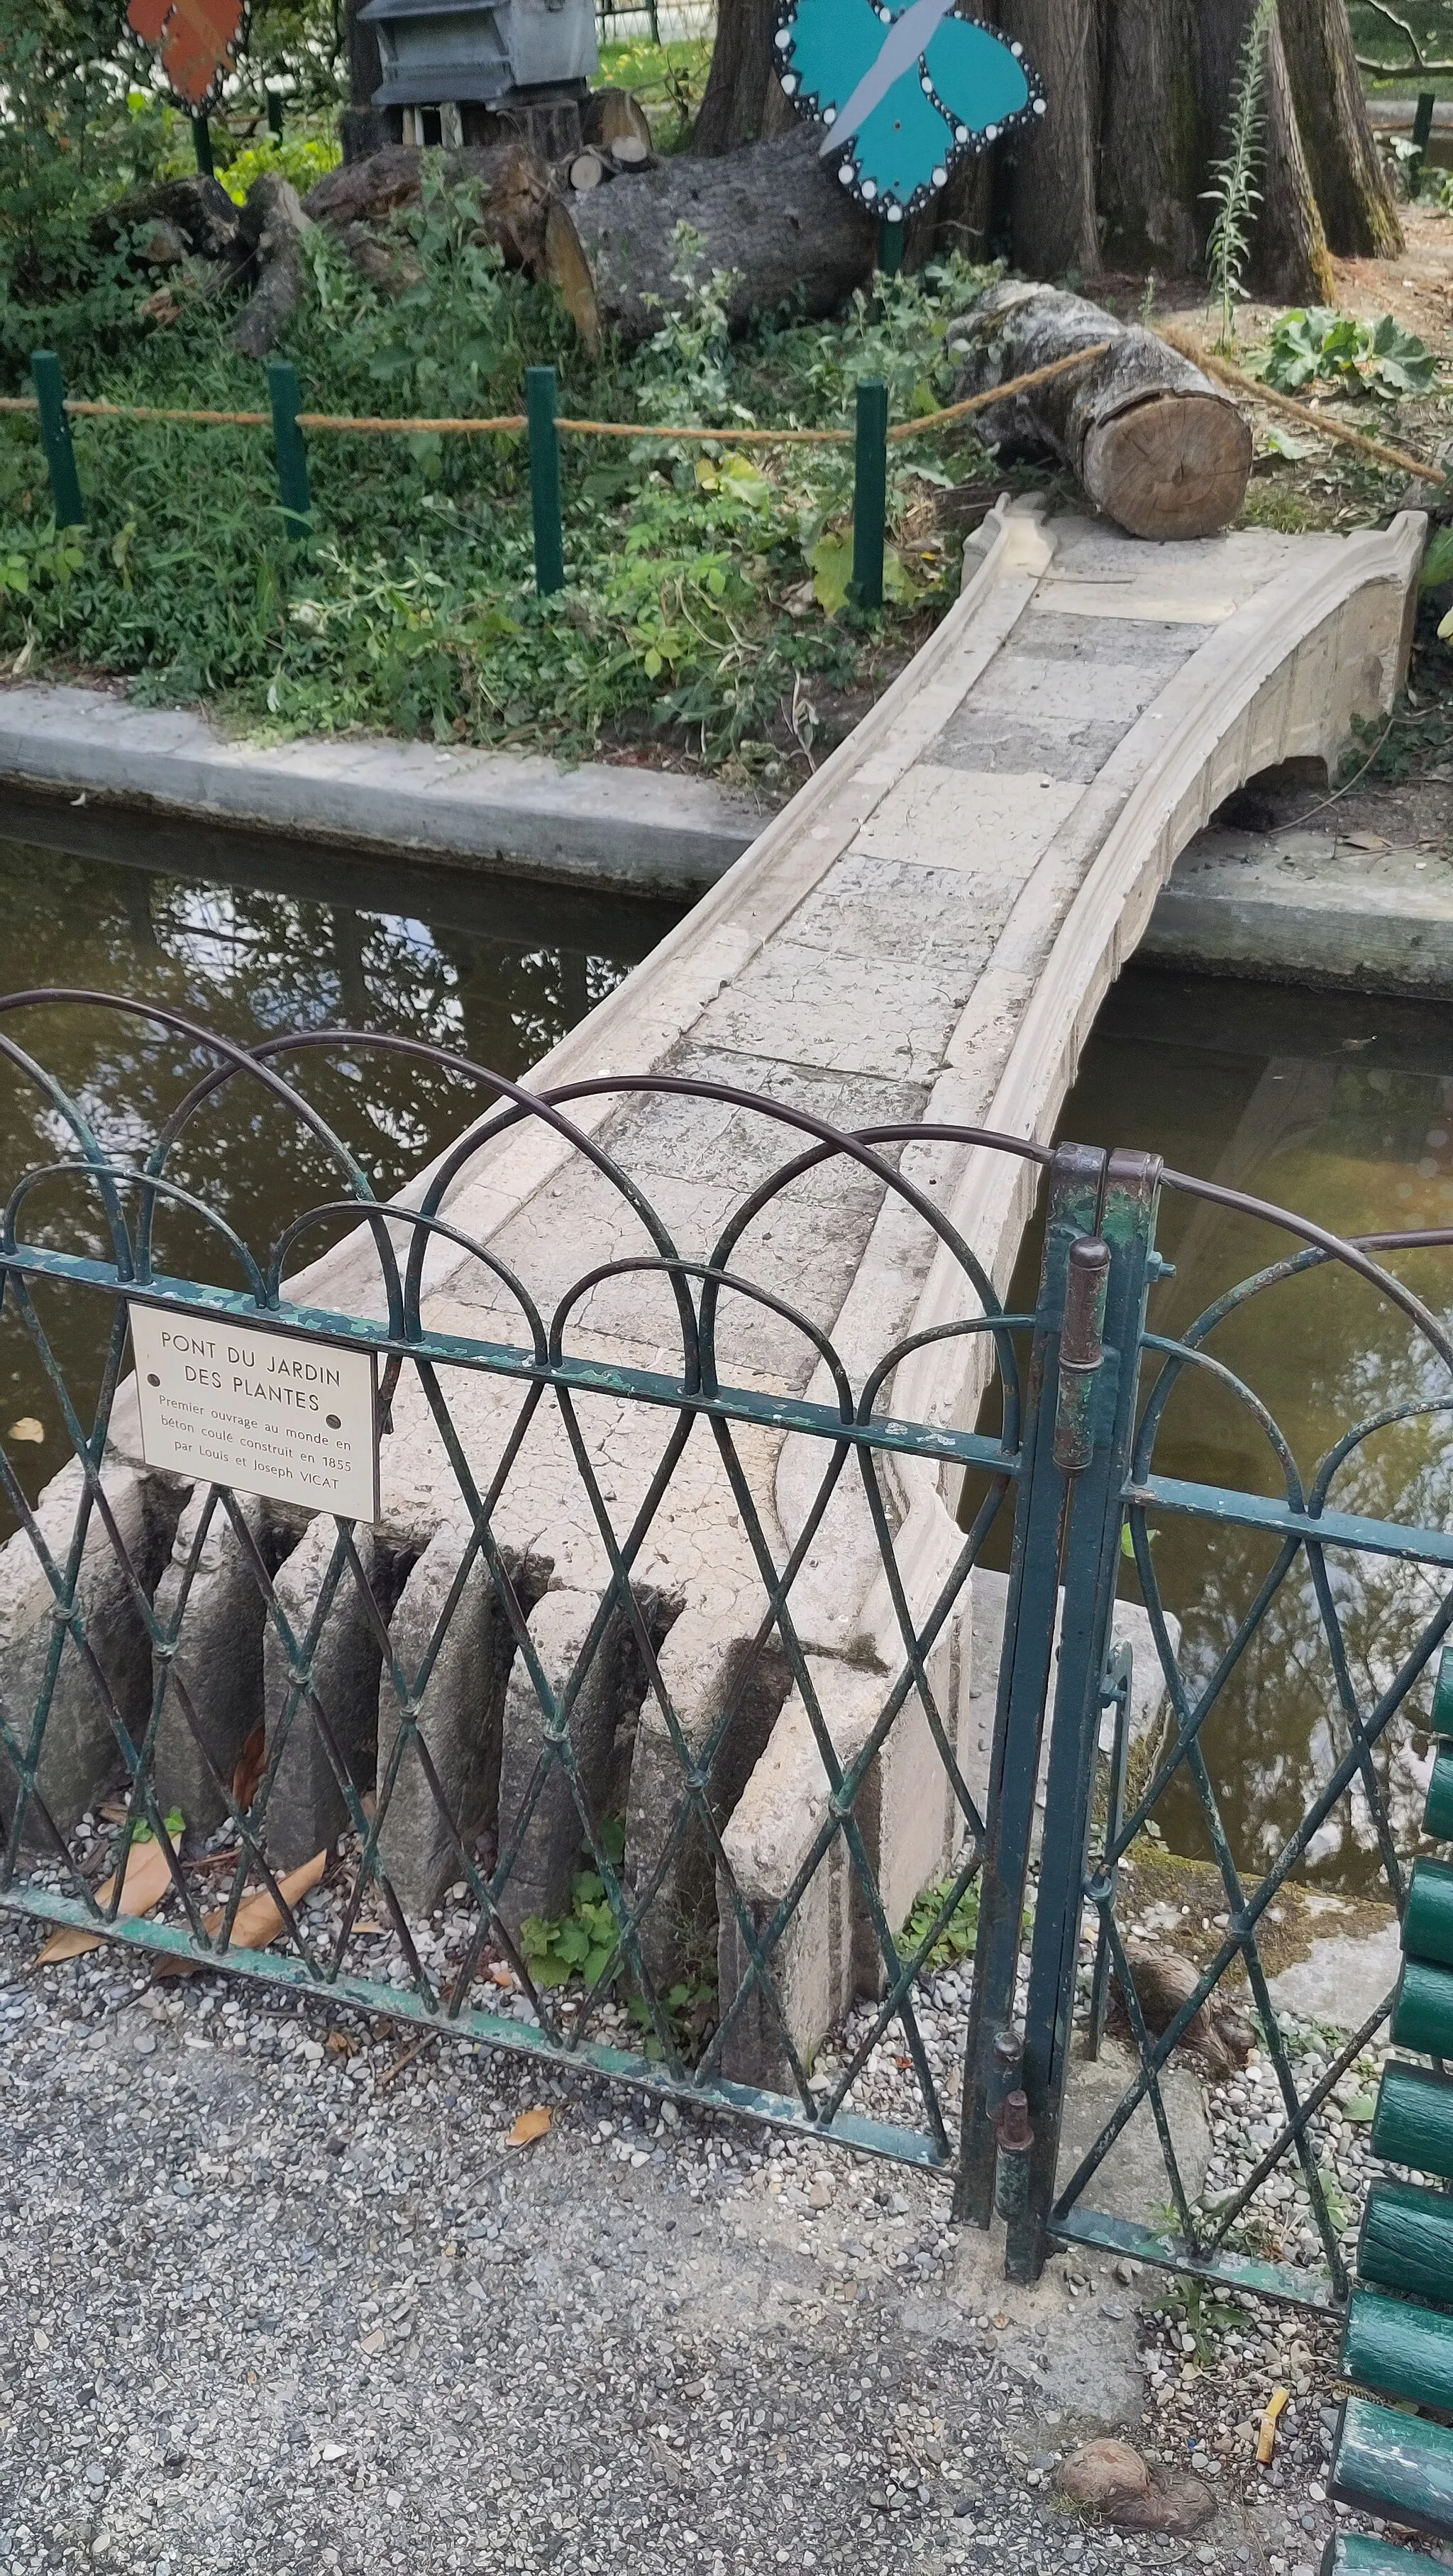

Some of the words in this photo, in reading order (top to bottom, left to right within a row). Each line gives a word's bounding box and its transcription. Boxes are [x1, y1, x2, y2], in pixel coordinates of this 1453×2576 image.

[161, 1332, 216, 1359] PONT
[228, 1347, 255, 1368] DU
[267, 1356, 341, 1387] JARDIN
[184, 1365, 221, 1388] DES
[233, 1376, 319, 1411] PLANTES
[159, 1395, 205, 1416] Premier
[211, 1410, 258, 1429] ouvrage
[265, 1422, 278, 1434] au
[286, 1427, 328, 1446] monde
[336, 1439, 351, 1451] en
[161, 1415, 194, 1432] béton
[201, 1426, 233, 1442] coulé
[240, 1437, 292, 1458] construit
[300, 1452, 315, 1463] en
[323, 1456, 351, 1471] 1855
[175, 1440, 192, 1452] par
[199, 1446, 228, 1462] Louis
[236, 1456, 247, 1467] et
[254, 1460, 292, 1478] Joseph
[299, 1471, 339, 1489] VICAT
